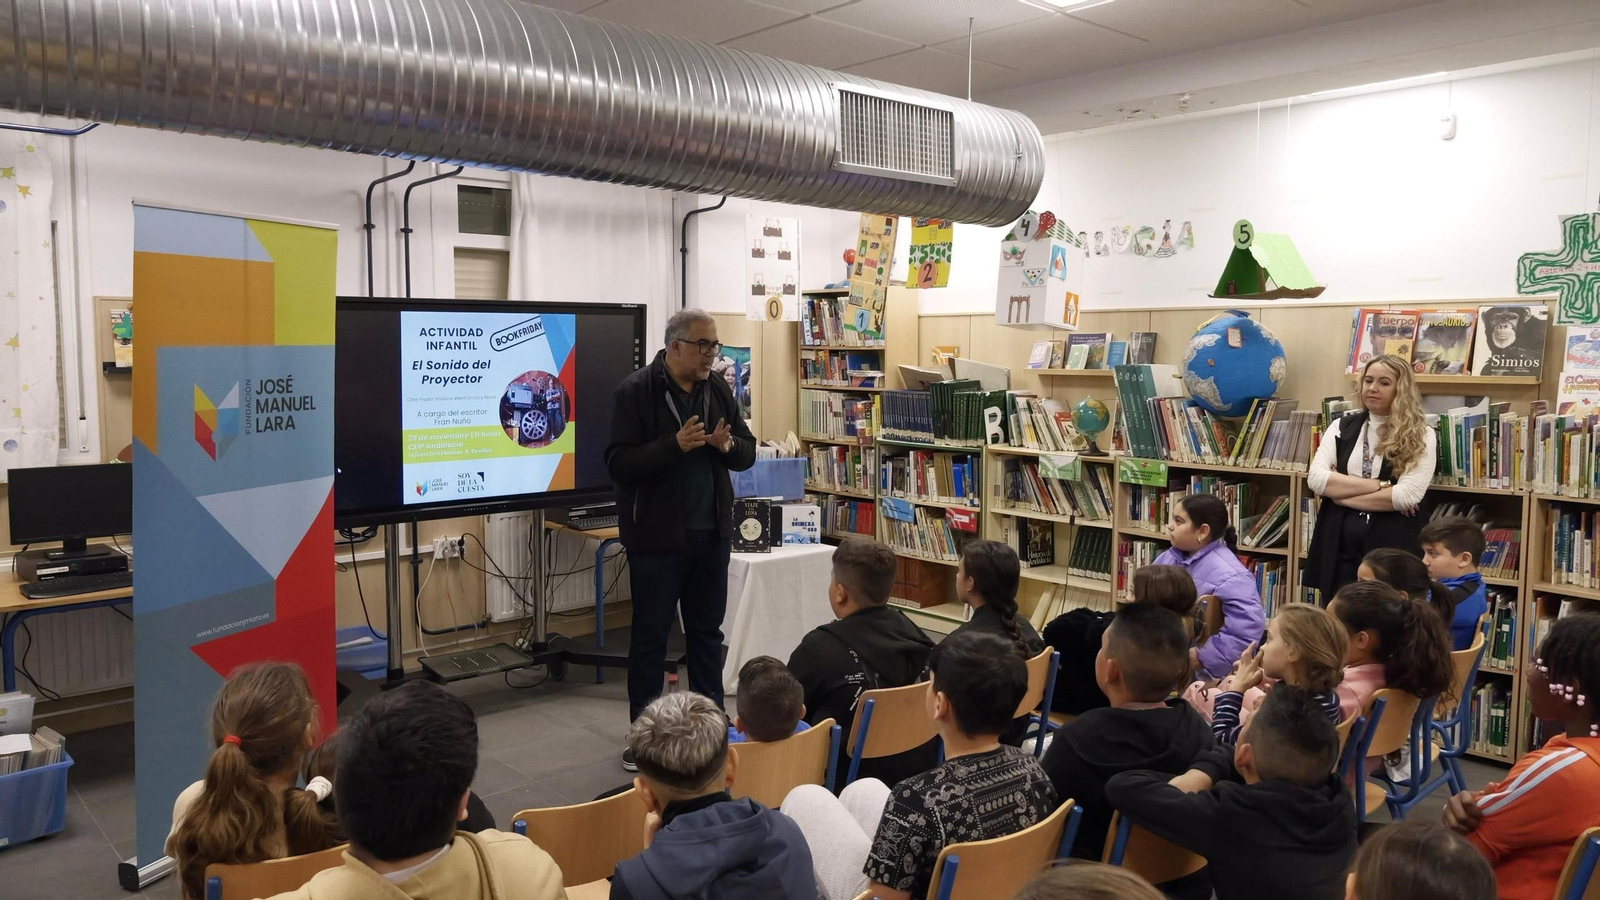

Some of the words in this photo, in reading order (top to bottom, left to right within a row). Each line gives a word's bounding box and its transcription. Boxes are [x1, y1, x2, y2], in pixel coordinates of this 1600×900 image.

[1020, 218, 1030, 237] 4
[1238, 223, 1250, 244] 5
[923, 263, 932, 283] 2
[1539, 266, 1575, 275] ABIERTO
[769, 300, 779, 319] 0
[858, 312, 865, 328] 1
[1378, 317, 1415, 329] cuerpo
[420, 327, 484, 337] ACTIVIDAD
[495, 321, 544, 347] BOOKFRIDAY
[426, 341, 478, 351] INFANTIL
[412, 360, 423, 370] El
[426, 359, 469, 370] Sonido
[472, 359, 491, 370] del
[1491, 354, 1540, 367] Simios
[255, 374, 294, 396] JOSÉ
[421, 374, 483, 387] Proyector
[255, 395, 317, 415] MANUEL
[423, 411, 446, 419] cargo
[447, 409, 460, 417] del
[460, 408, 488, 416] escritor
[256, 415, 296, 433] LARA
[434, 418, 451, 426] Fran
[452, 417, 472, 425] Nuño
[983, 406, 1005, 445] B
[418, 433, 428, 441] de
[429, 432, 469, 441] noviembre
[481, 430, 502, 438] horas
[457, 472, 472, 480] SOY
[457, 485, 485, 494] CUESTA
